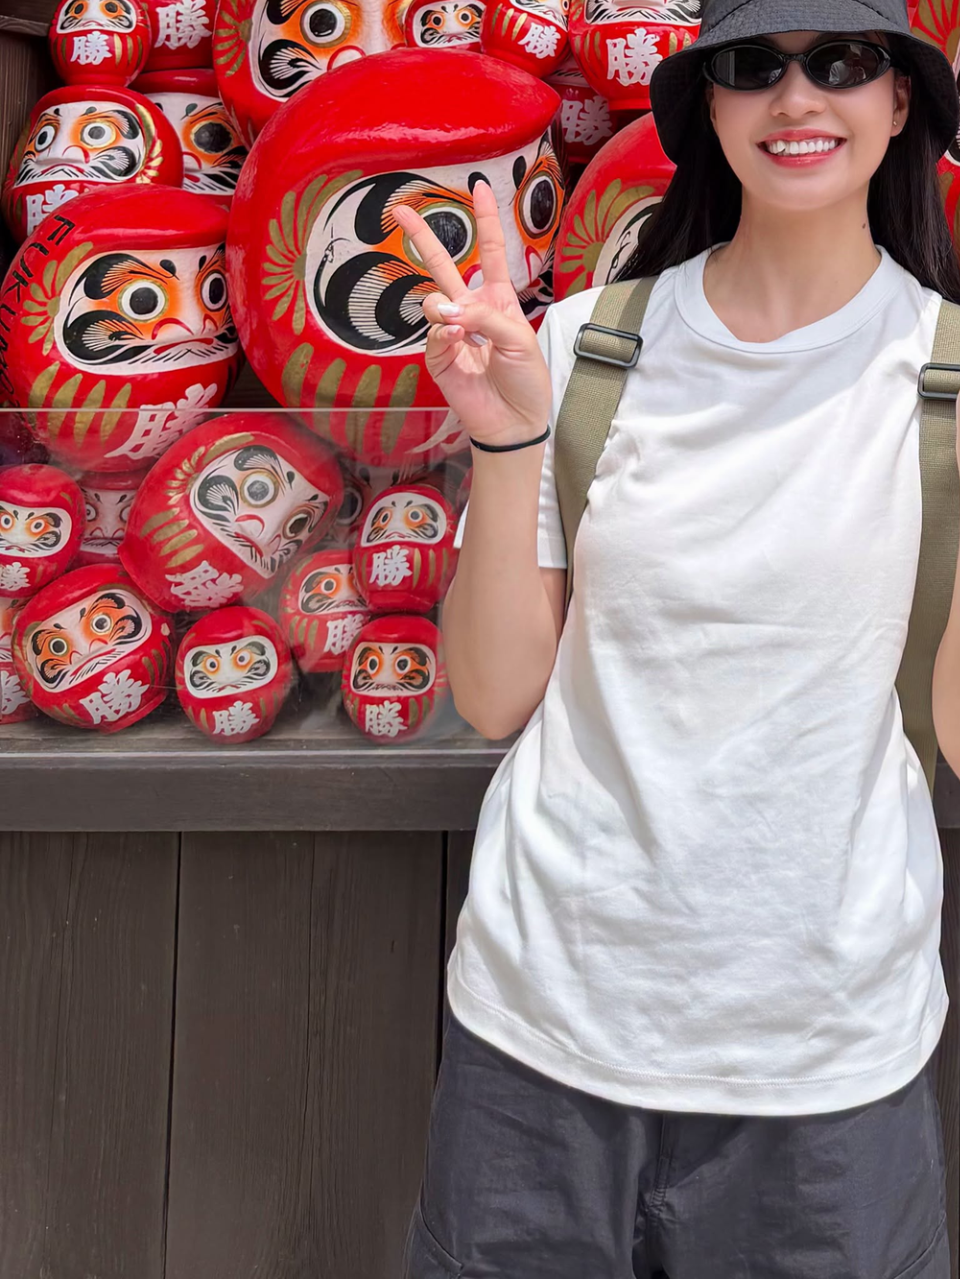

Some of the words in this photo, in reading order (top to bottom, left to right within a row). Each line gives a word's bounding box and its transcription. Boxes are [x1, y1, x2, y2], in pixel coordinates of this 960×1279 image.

[70, 30, 113, 66] 勝
[518, 22, 562, 59] 勝
[606, 27, 664, 87] 勝
[561, 94, 612, 144] 勝
[104, 382, 218, 460] 勝
[165, 560, 244, 609] 勝
[370, 545, 413, 588] 勝
[79, 669, 149, 725] 勝
[212, 700, 260, 737] 勝
[365, 700, 408, 737] 勝
